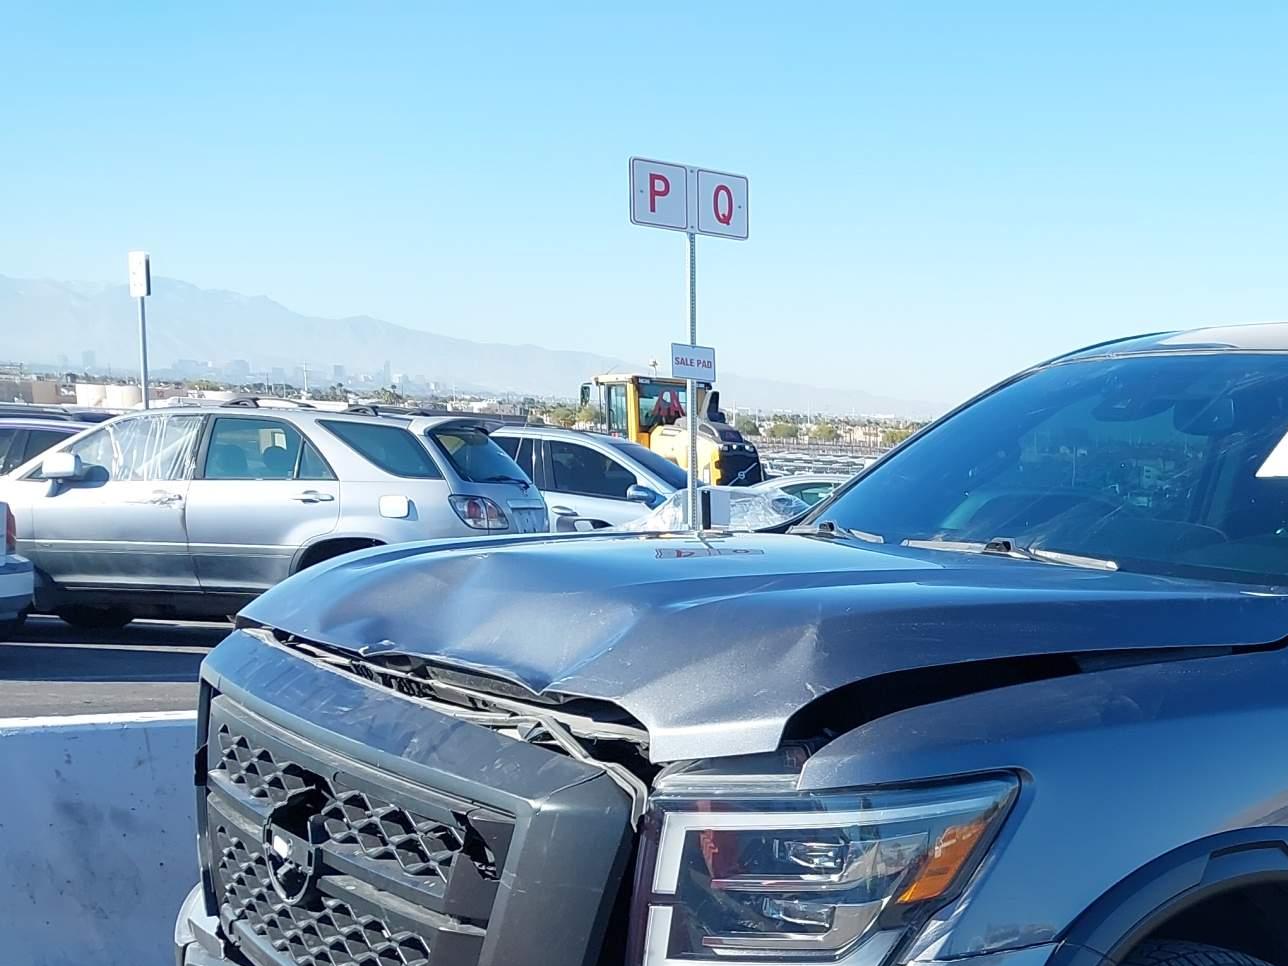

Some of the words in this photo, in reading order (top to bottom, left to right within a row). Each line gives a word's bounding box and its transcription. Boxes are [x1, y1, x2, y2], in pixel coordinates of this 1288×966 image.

[649, 173, 670, 212] P
[713, 184, 734, 226] Q
[674, 356, 695, 367] SALE
[696, 359, 712, 369] PAD
